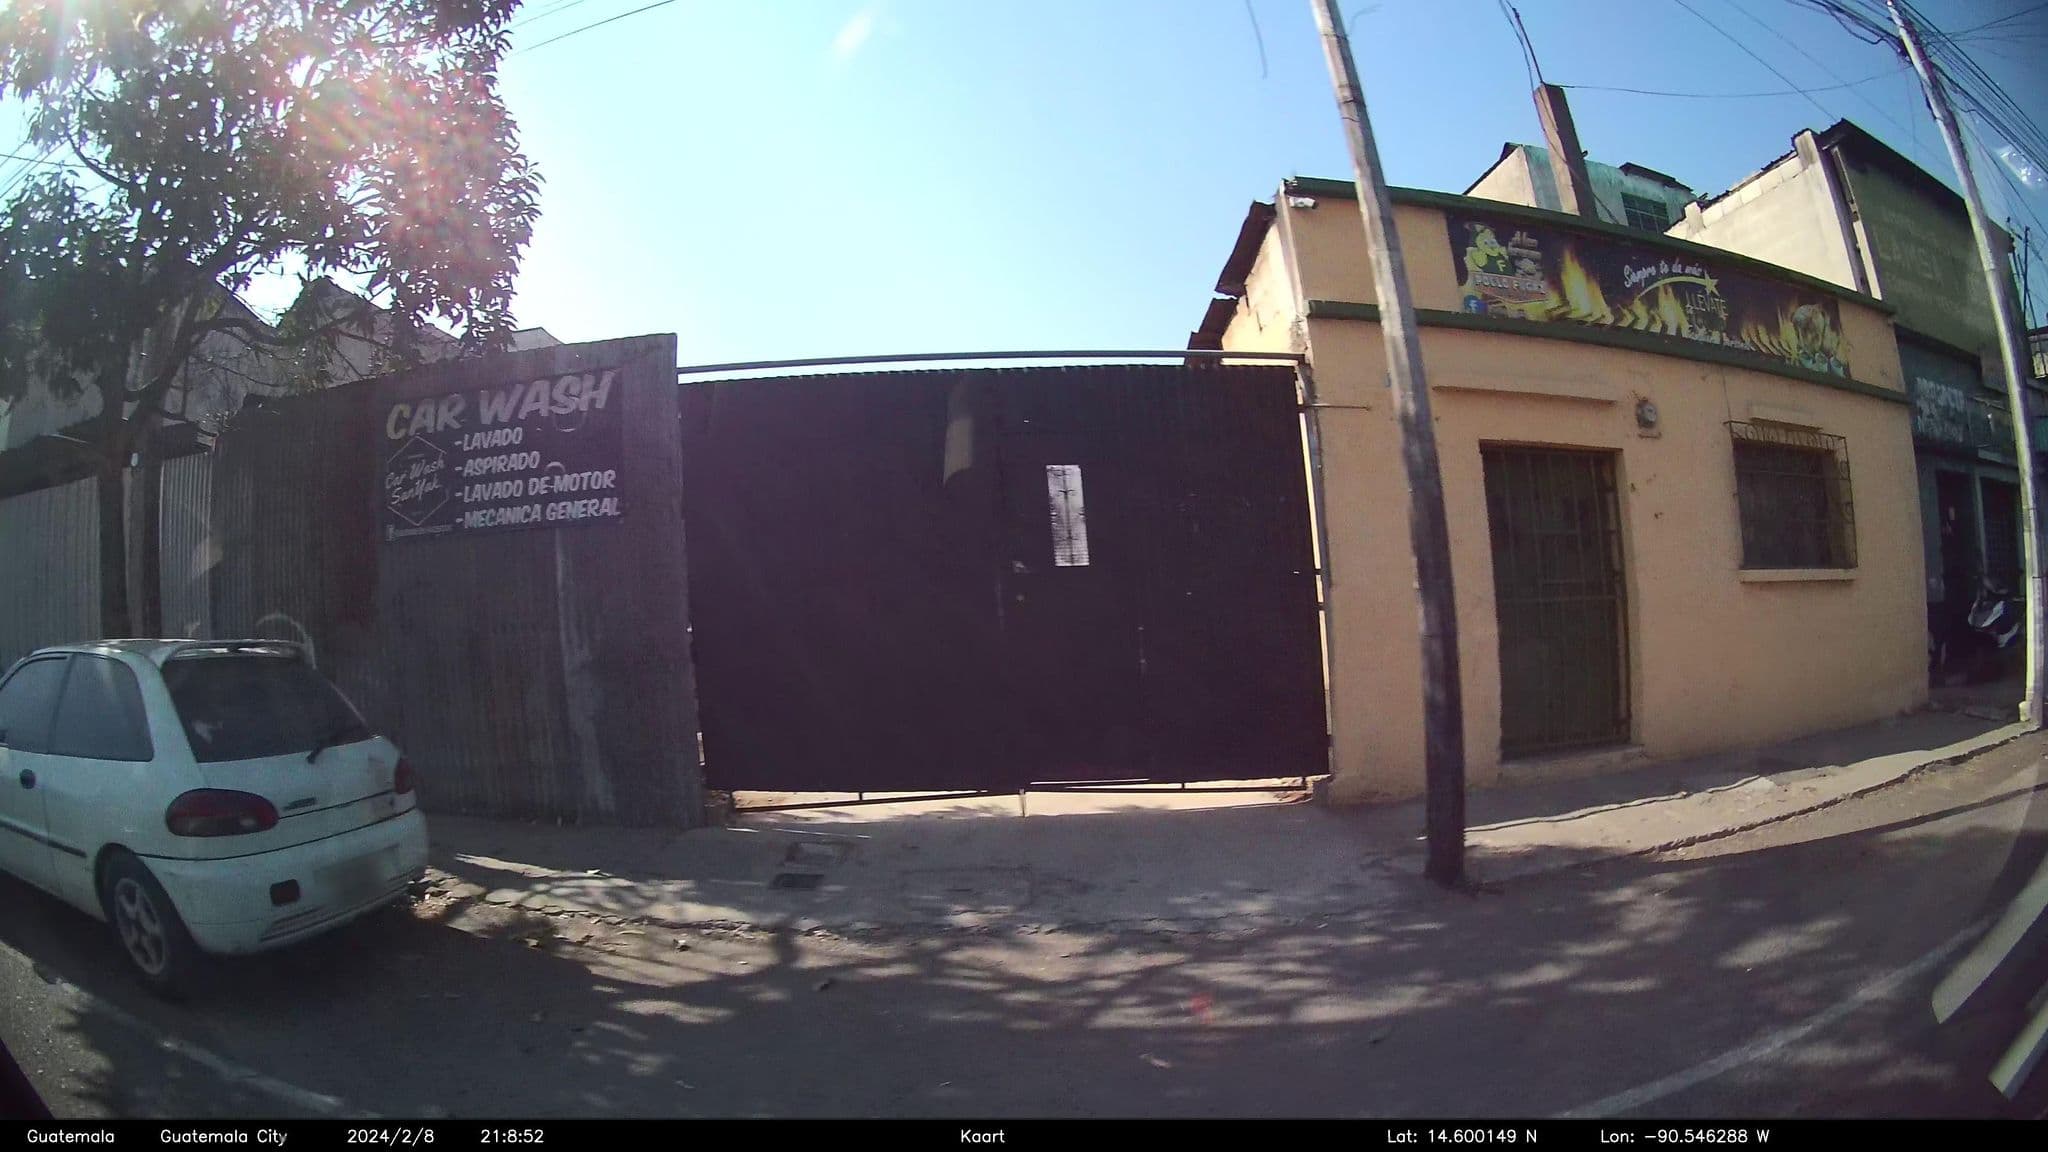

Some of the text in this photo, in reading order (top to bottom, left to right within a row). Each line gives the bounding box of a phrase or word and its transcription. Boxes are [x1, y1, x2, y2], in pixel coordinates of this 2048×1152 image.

[386, 371, 616, 440] CAR WASH
[528, 476, 551, 496] DE
[553, 469, 617, 493] MOTOR
[545, 498, 621, 521] GENERAL
